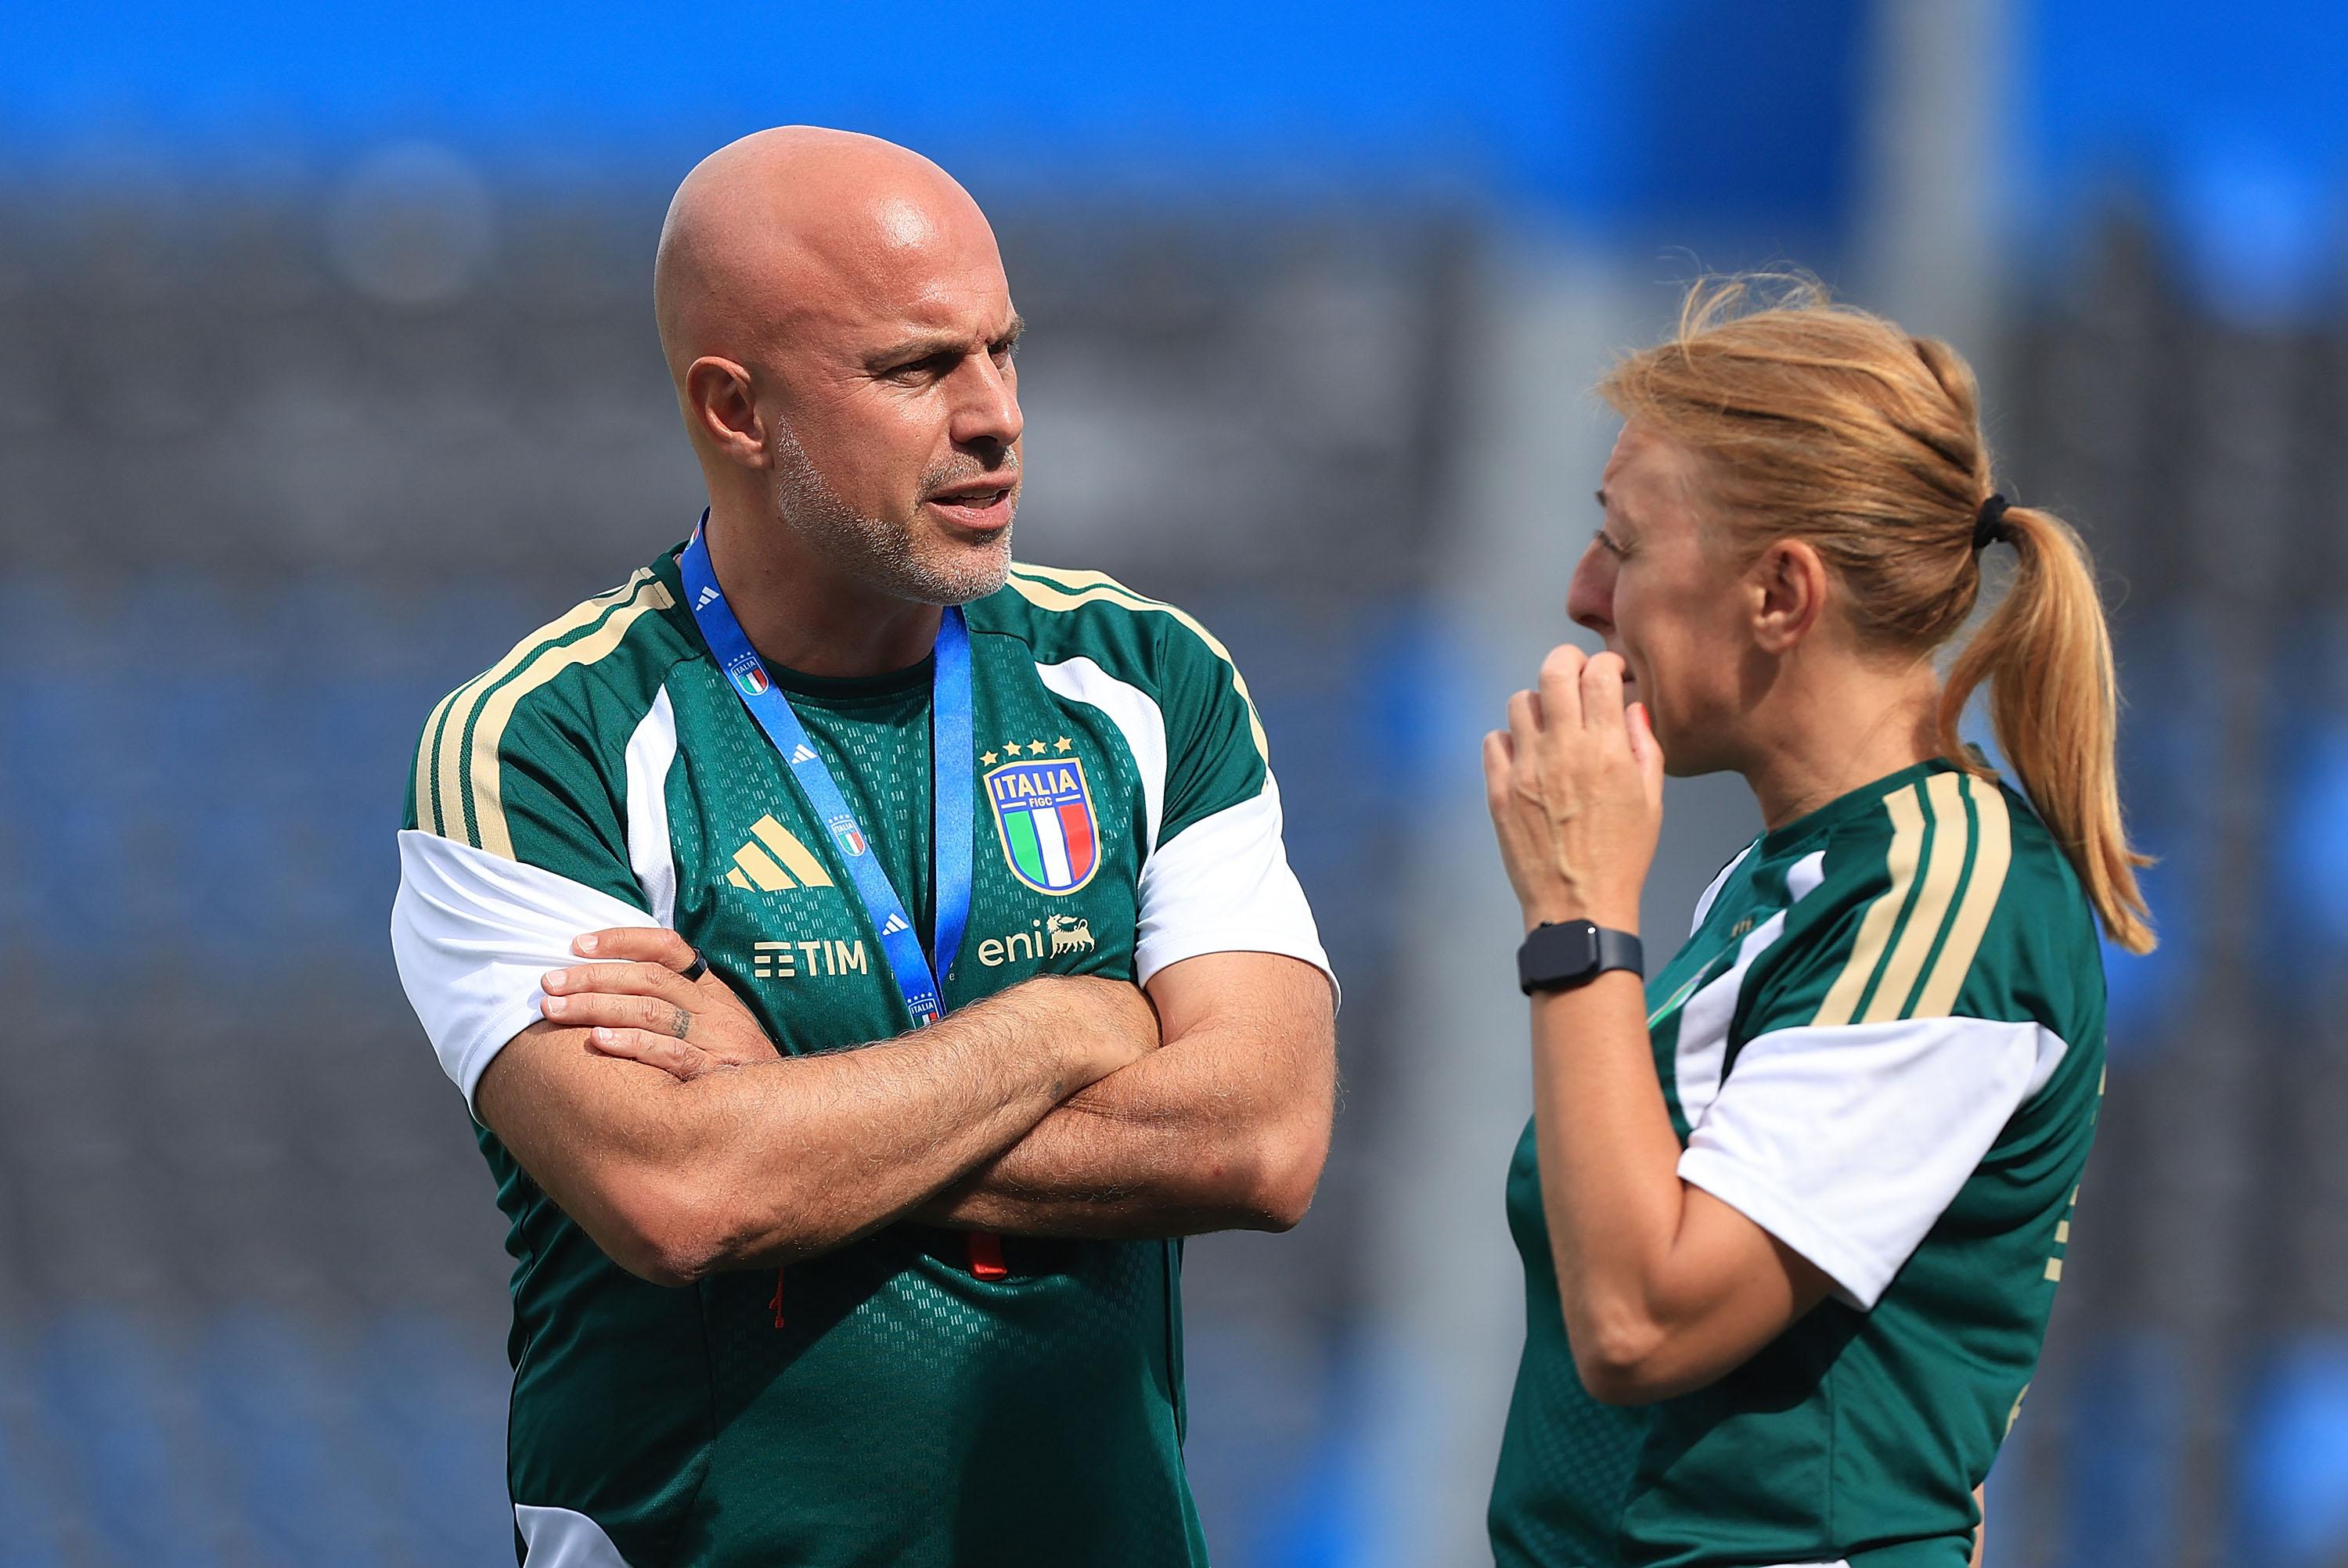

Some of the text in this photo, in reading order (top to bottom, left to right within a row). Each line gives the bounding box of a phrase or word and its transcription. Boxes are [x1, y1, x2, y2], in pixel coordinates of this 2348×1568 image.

[733, 660, 756, 676] ITALIA
[993, 768, 1079, 800] ITALIA
[1028, 797, 1053, 807] FIGC
[978, 919, 1044, 966] eni
[797, 940, 867, 976] TIM
[910, 1002, 935, 1015] ITALIA
